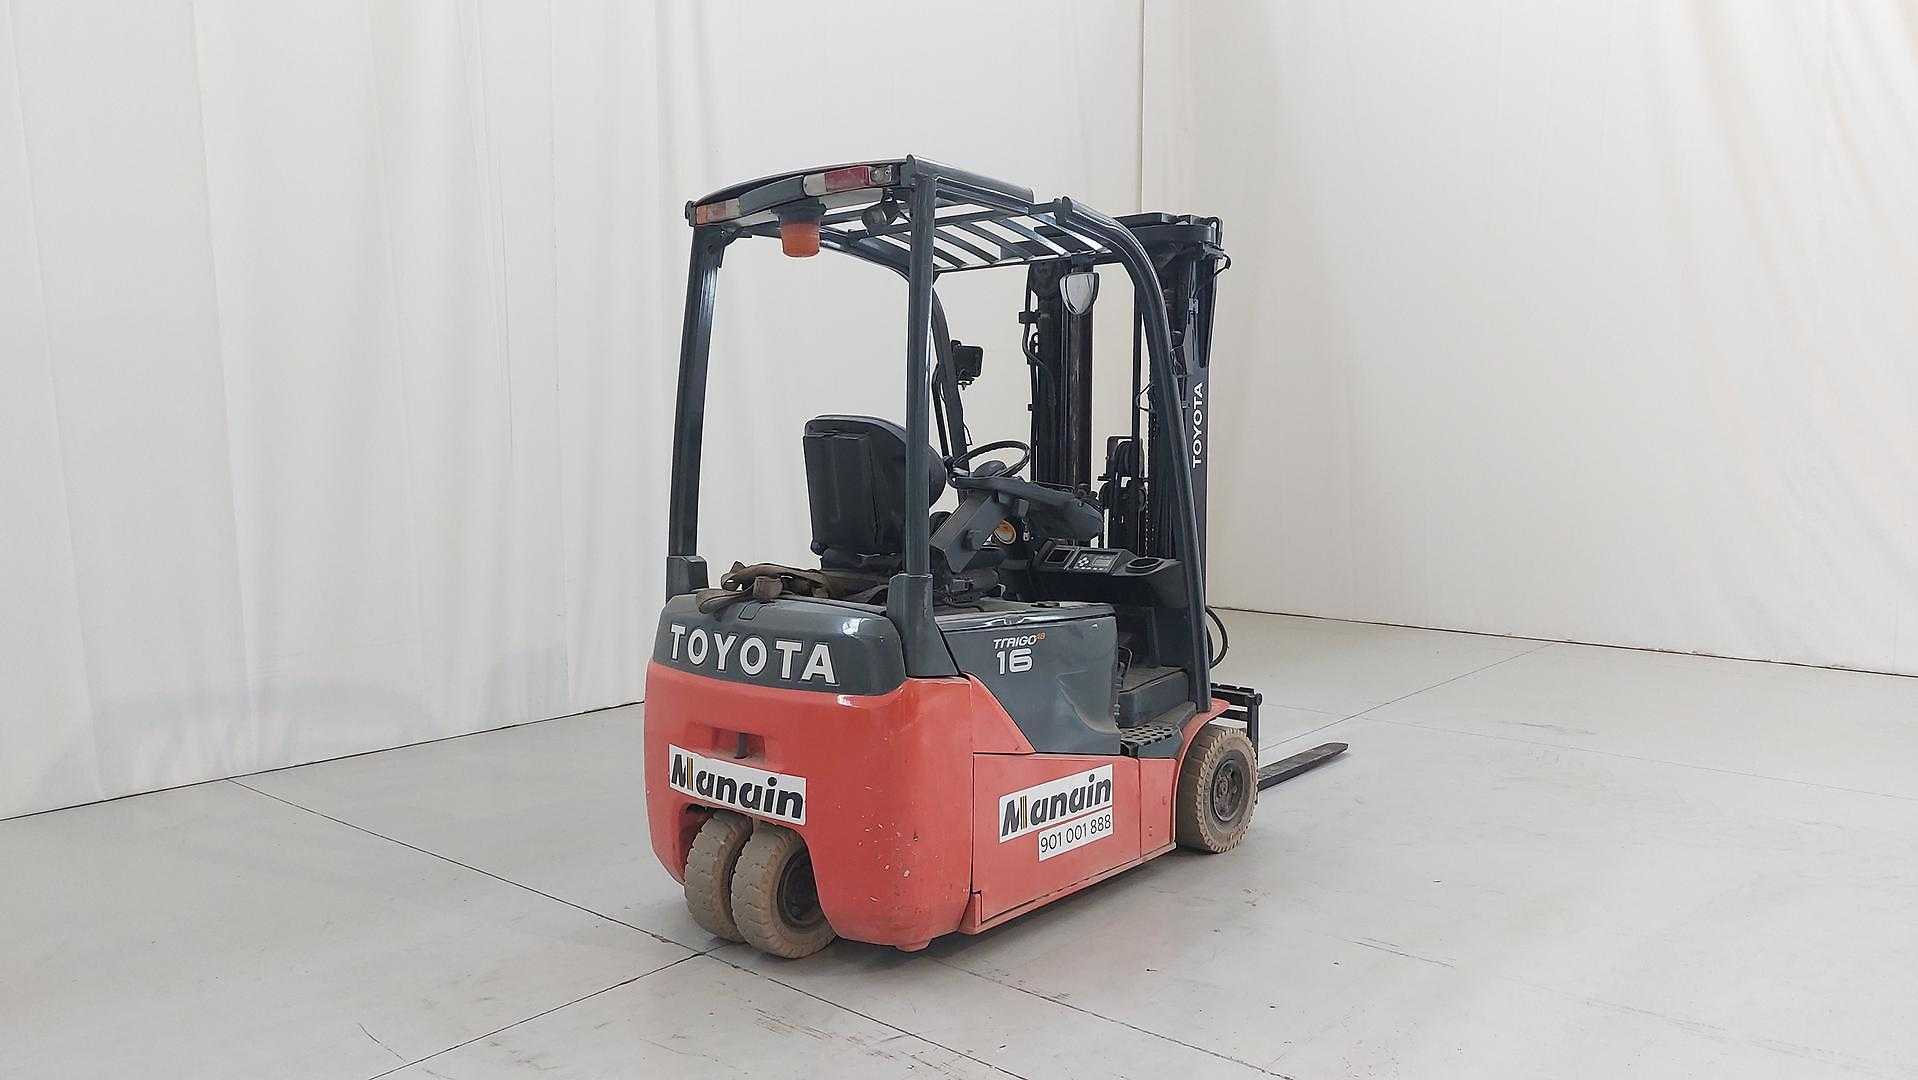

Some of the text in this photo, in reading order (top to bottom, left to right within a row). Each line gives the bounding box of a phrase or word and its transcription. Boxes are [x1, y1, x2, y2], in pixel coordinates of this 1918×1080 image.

[1192, 382, 1203, 469] TOYOTA
[670, 623, 837, 685] TOYOTA
[996, 647, 1033, 675] 16
[670, 753, 804, 820] Manain
[1001, 773, 1112, 837] Manain
[1040, 814, 1111, 853] 901 001 888
